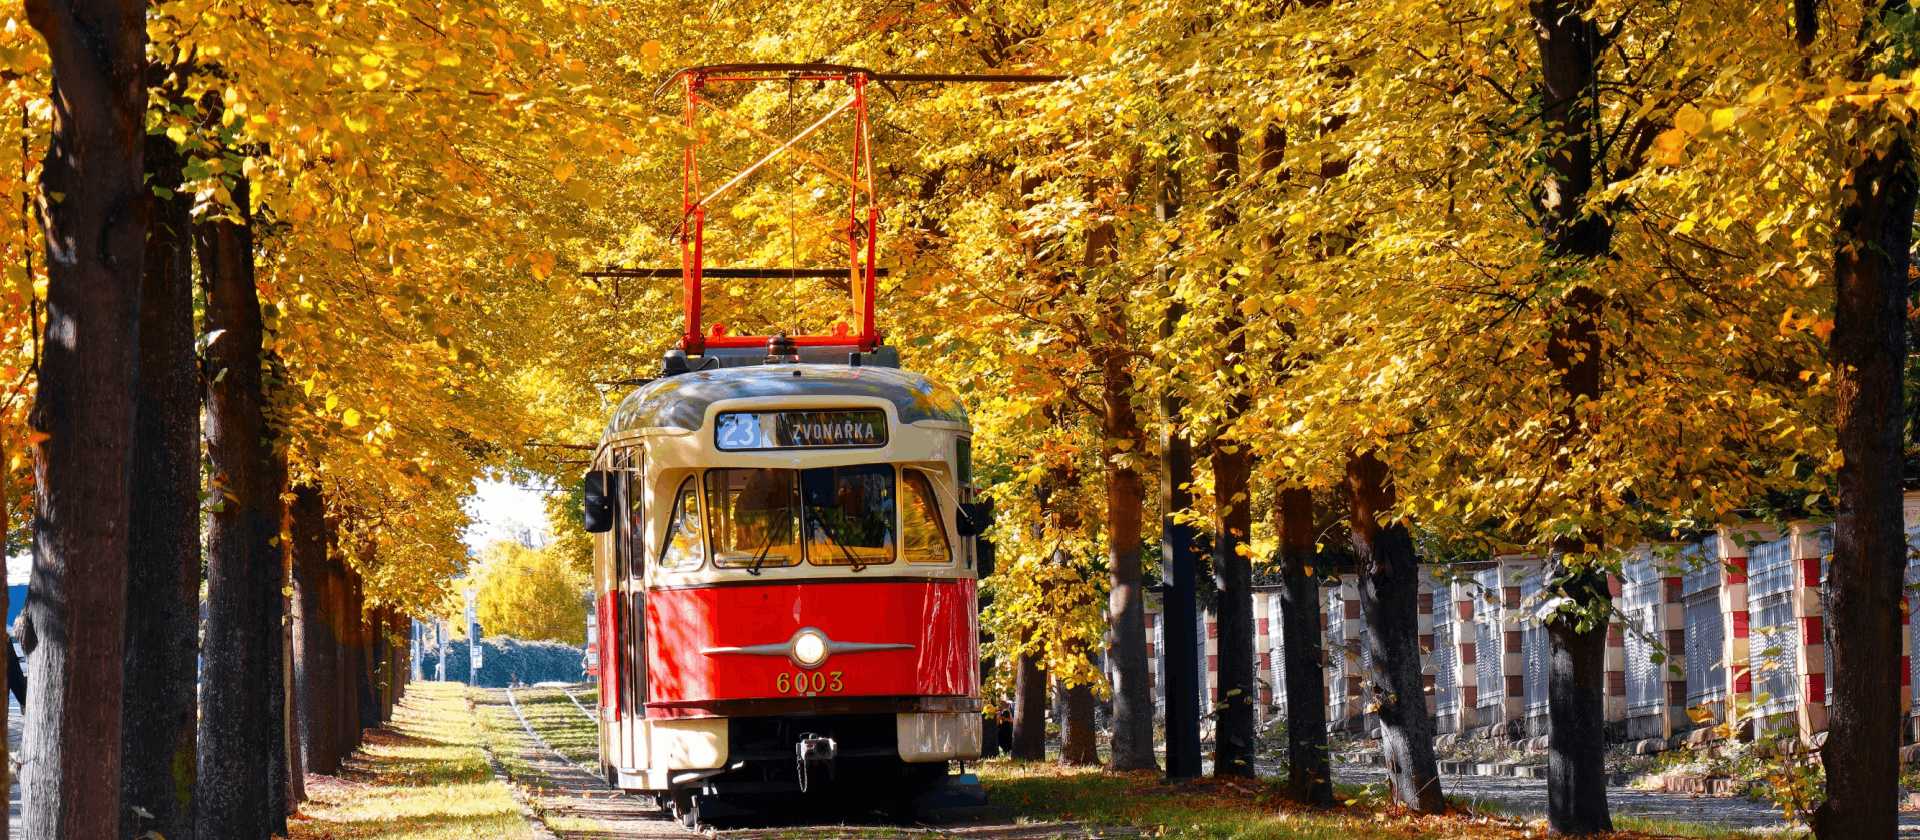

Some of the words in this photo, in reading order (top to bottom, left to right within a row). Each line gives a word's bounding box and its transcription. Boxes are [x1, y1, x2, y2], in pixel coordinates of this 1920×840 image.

[724, 416, 755, 446] 23
[792, 419, 875, 441] ZVONAŘKA
[776, 671, 844, 693] 6003
